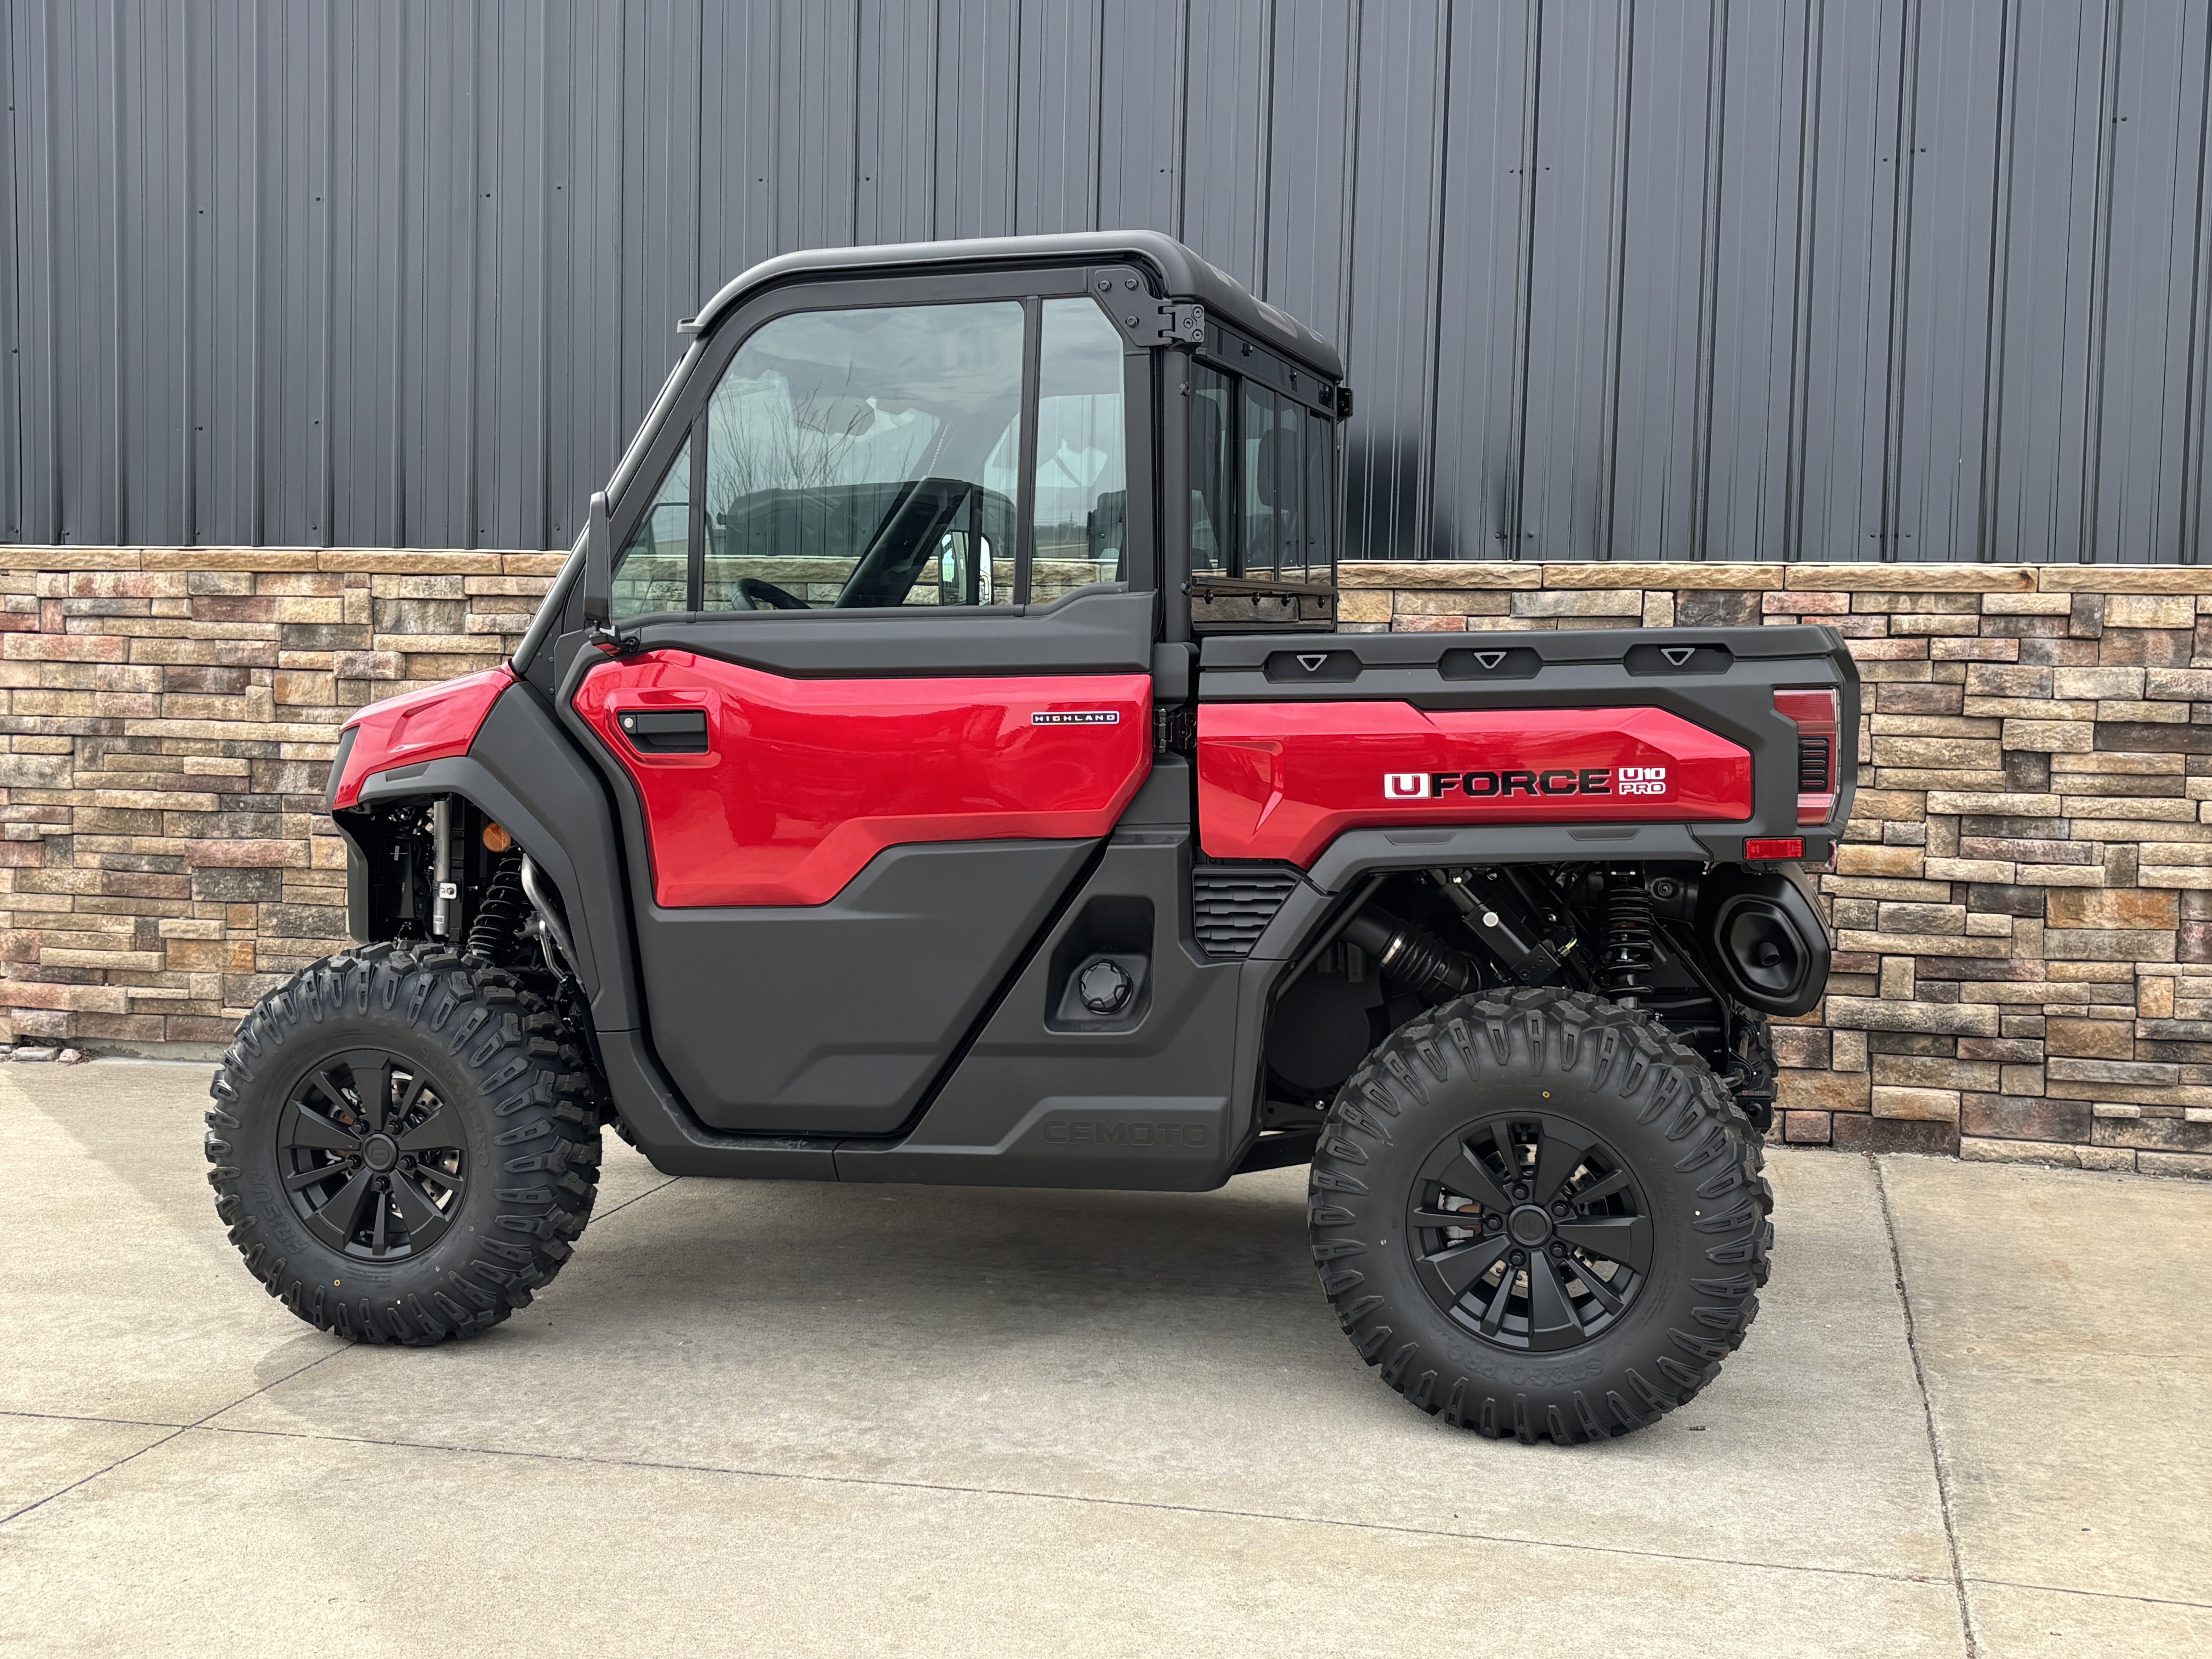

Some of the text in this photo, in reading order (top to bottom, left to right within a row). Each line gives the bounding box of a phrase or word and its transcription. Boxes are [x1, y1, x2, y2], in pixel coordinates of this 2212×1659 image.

[1619, 768, 1666, 781] U10
[1619, 781, 1666, 795] PRO
[1042, 1120, 1211, 1148] CFMOTO
[249, 1166, 311, 1255] ARISUN
